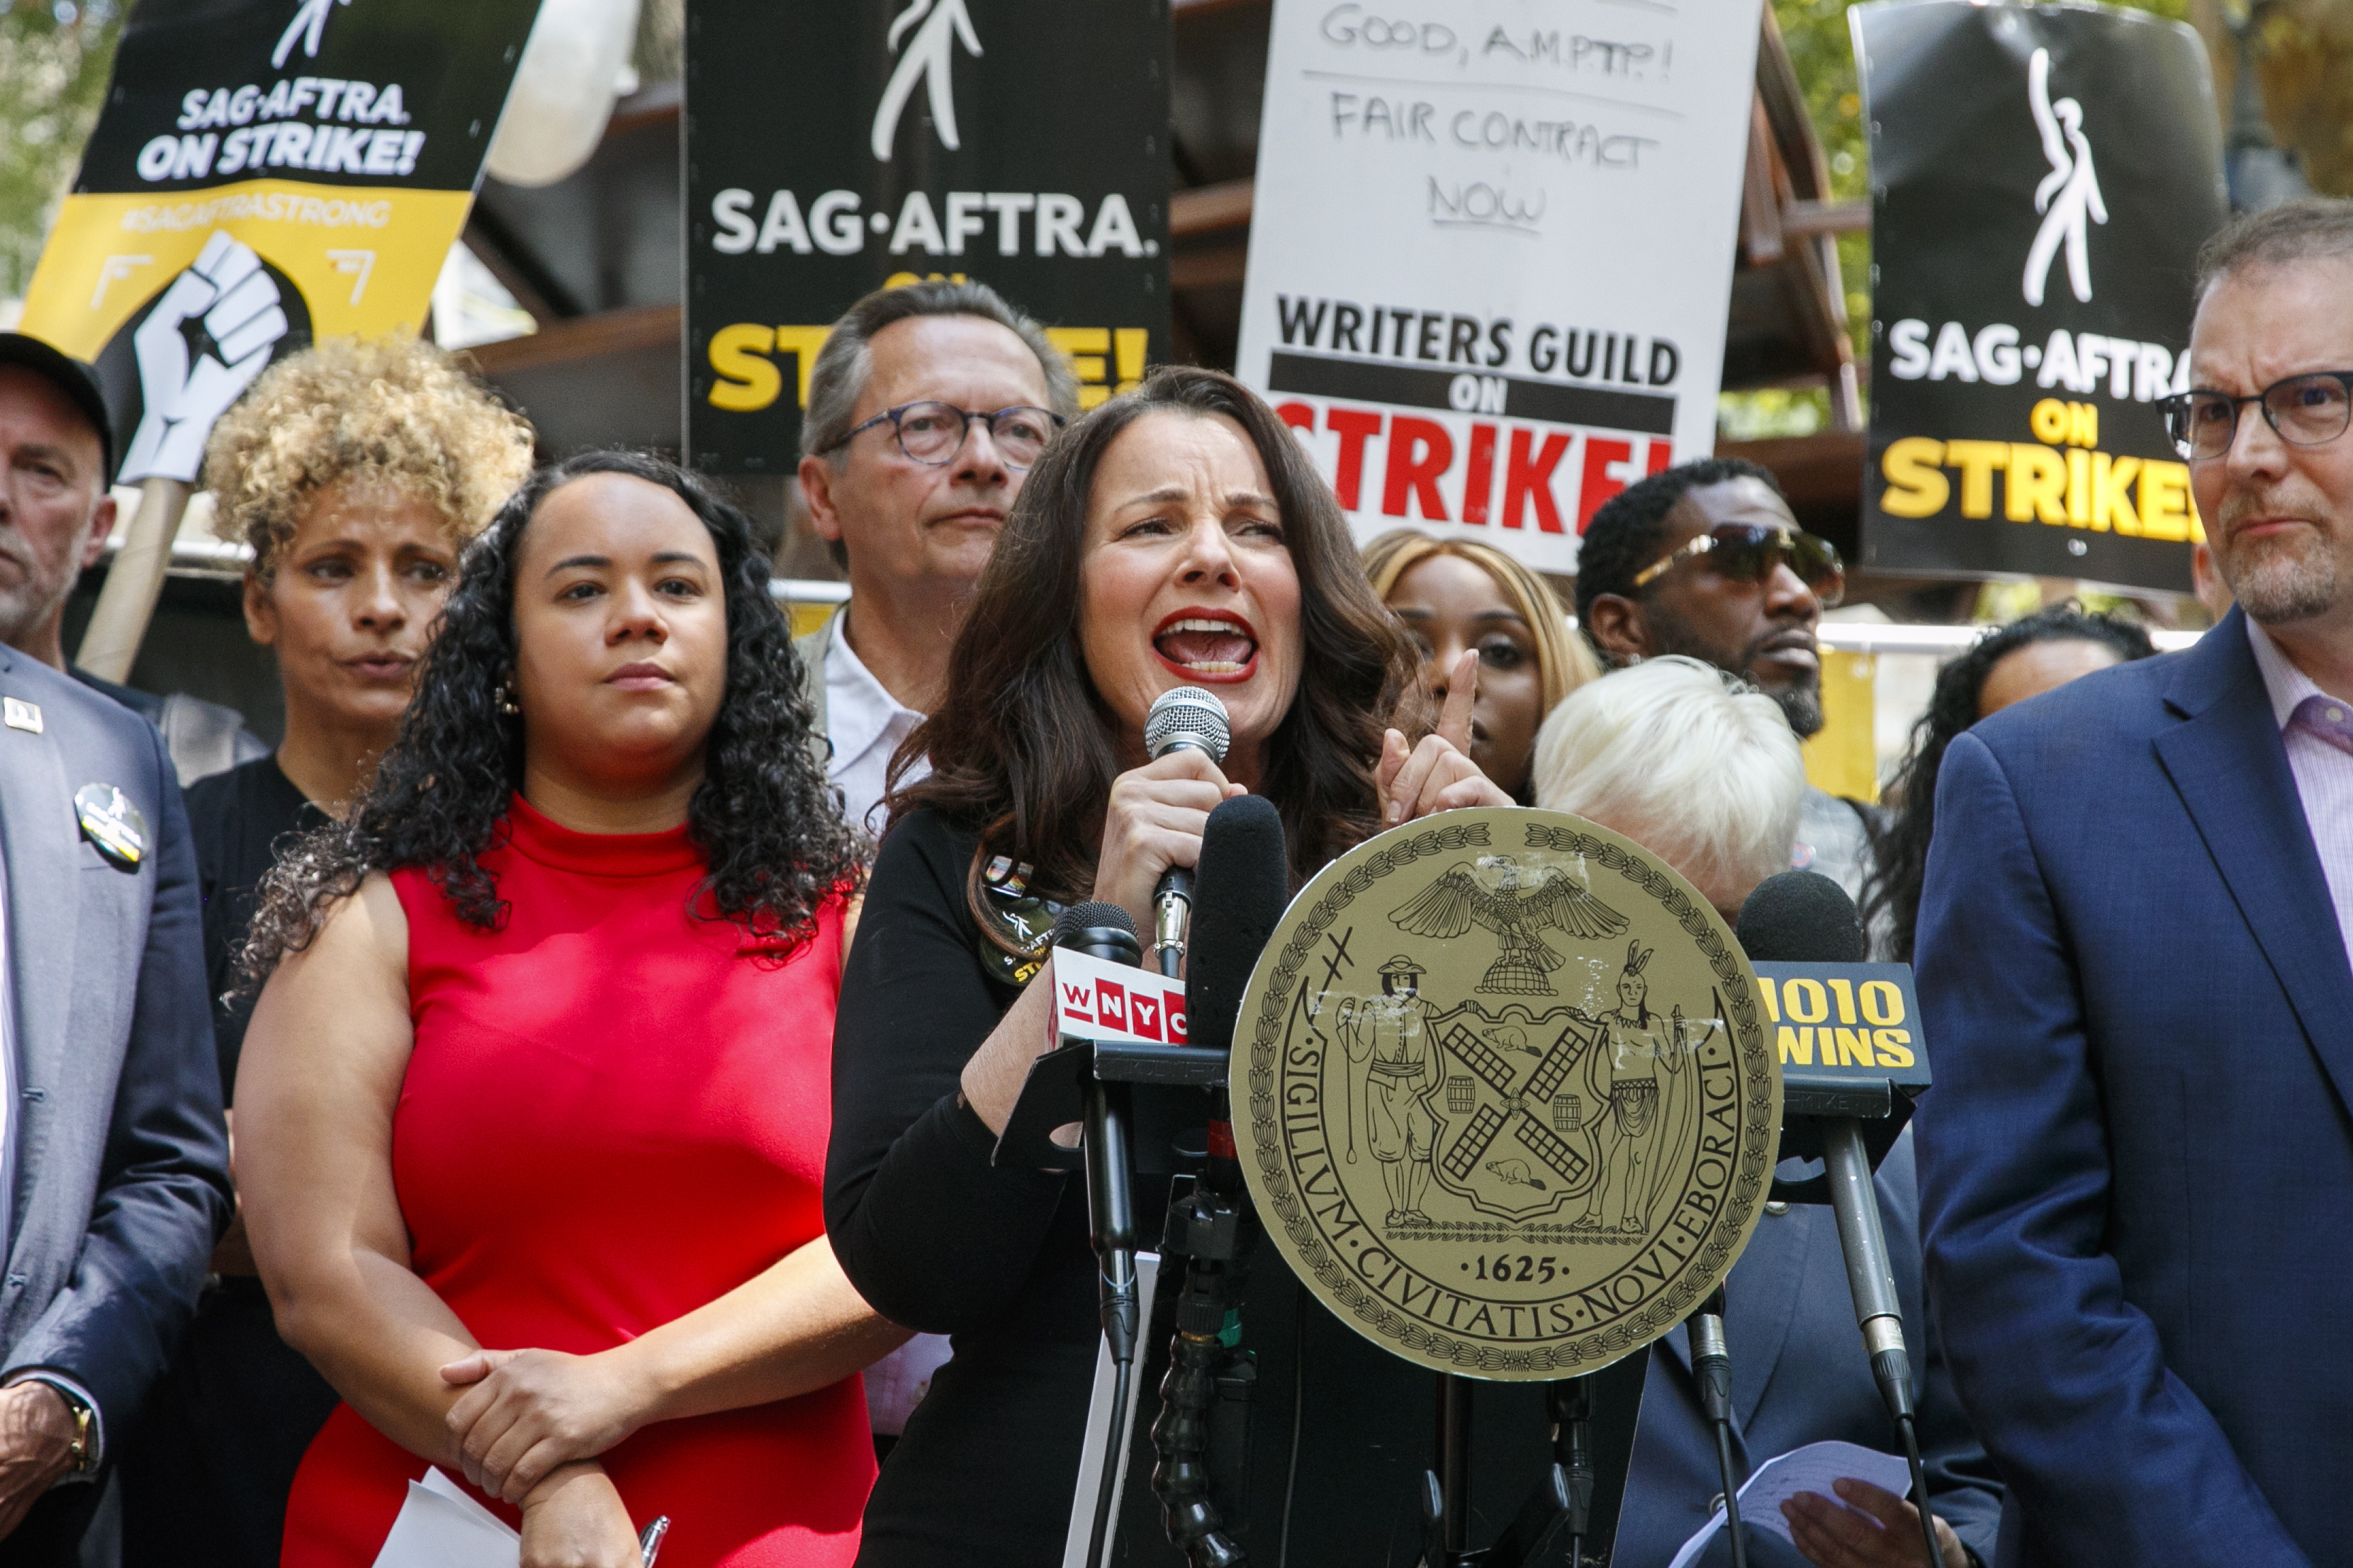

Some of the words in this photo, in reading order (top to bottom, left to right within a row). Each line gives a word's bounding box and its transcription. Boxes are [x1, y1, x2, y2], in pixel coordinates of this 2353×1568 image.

[1320, 3, 1470, 69] GOOD,
[136, 133, 220, 182] ON
[215, 123, 425, 176] STRIKE!
[1330, 91, 1437, 143] FAIR
[1449, 110, 1661, 169] CONTRACT
[120, 191, 392, 232] #SAGAFTRASTRONG
[1426, 174, 1546, 224] NOW
[1276, 293, 1512, 368] WRITERS
[1528, 325, 1682, 387] GUILD
[1448, 373, 1508, 416] ON
[2031, 397, 2099, 449] ON
[1062, 983, 1187, 1035] WNYC
[1756, 977, 1906, 1026] 1010
[1777, 1026, 1915, 1068] WINS
[1579, 1246, 1685, 1311] NOVI
